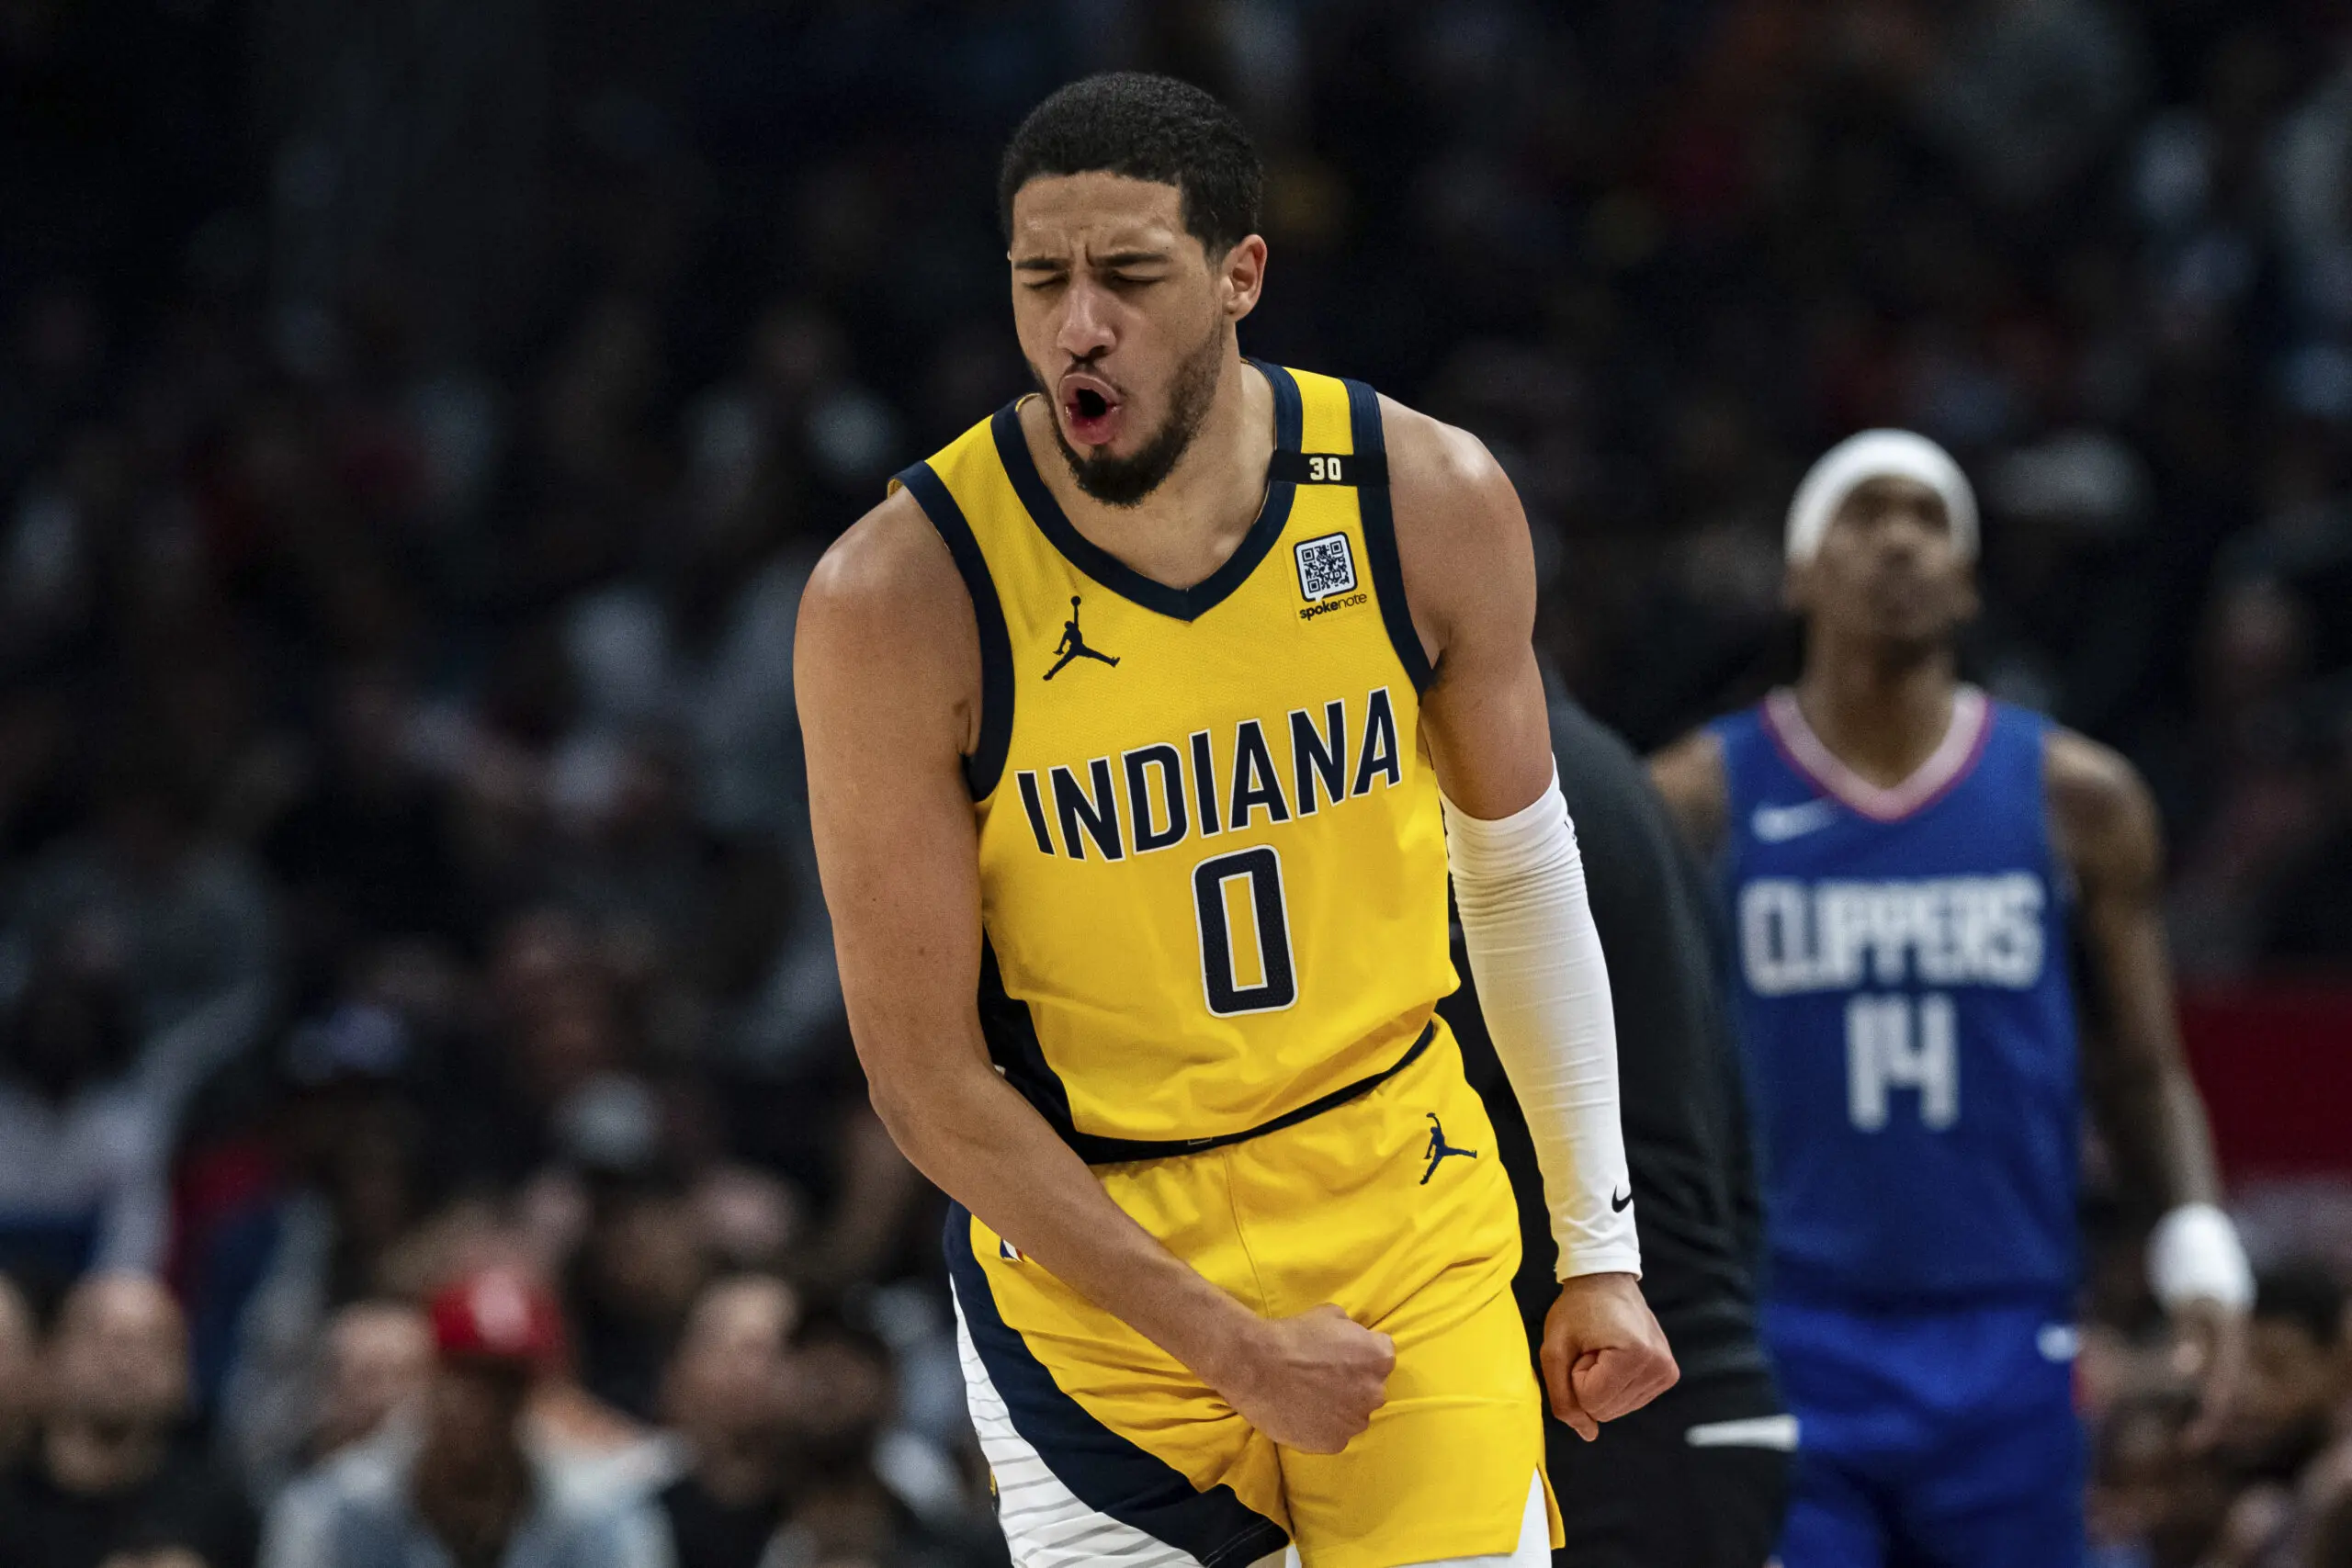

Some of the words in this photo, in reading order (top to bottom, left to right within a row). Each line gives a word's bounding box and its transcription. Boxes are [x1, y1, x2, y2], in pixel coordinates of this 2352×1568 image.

[1309, 457, 1342, 481] 30
[1299, 592, 1368, 621] spokenote
[1014, 685, 1402, 863] INDIANA
[1191, 844, 1299, 1019] 0
[1739, 874, 2046, 997] CLIPPERS
[1846, 992, 1959, 1132] 14
